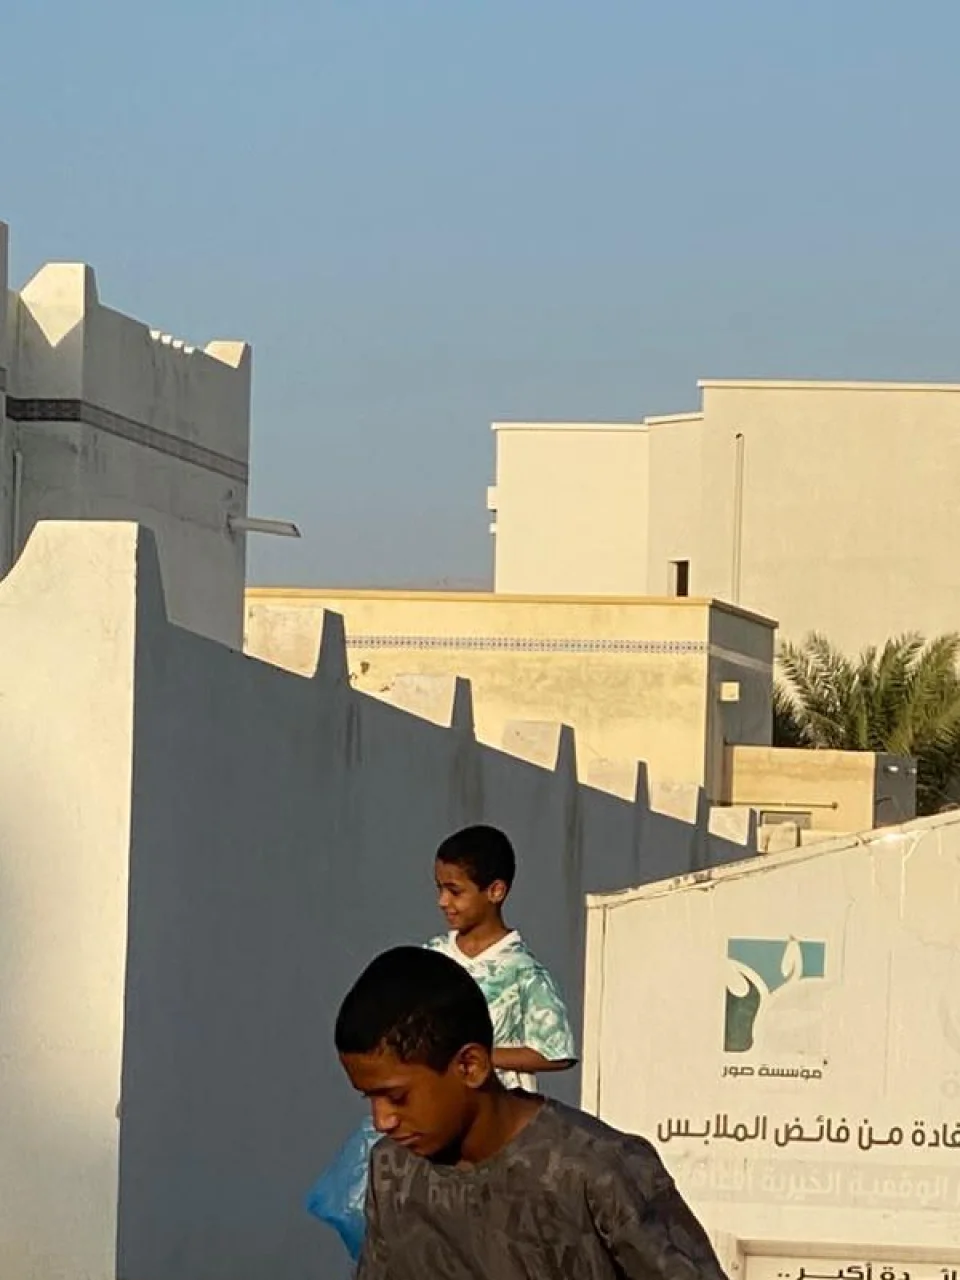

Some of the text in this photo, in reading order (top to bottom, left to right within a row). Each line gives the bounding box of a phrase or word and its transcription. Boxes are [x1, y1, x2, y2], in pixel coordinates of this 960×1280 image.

[721, 1066, 755, 1078] صور
[657, 1113, 767, 1145] الملابس
[774, 1114, 850, 1147] فائض
[857, 1118, 904, 1150] من
